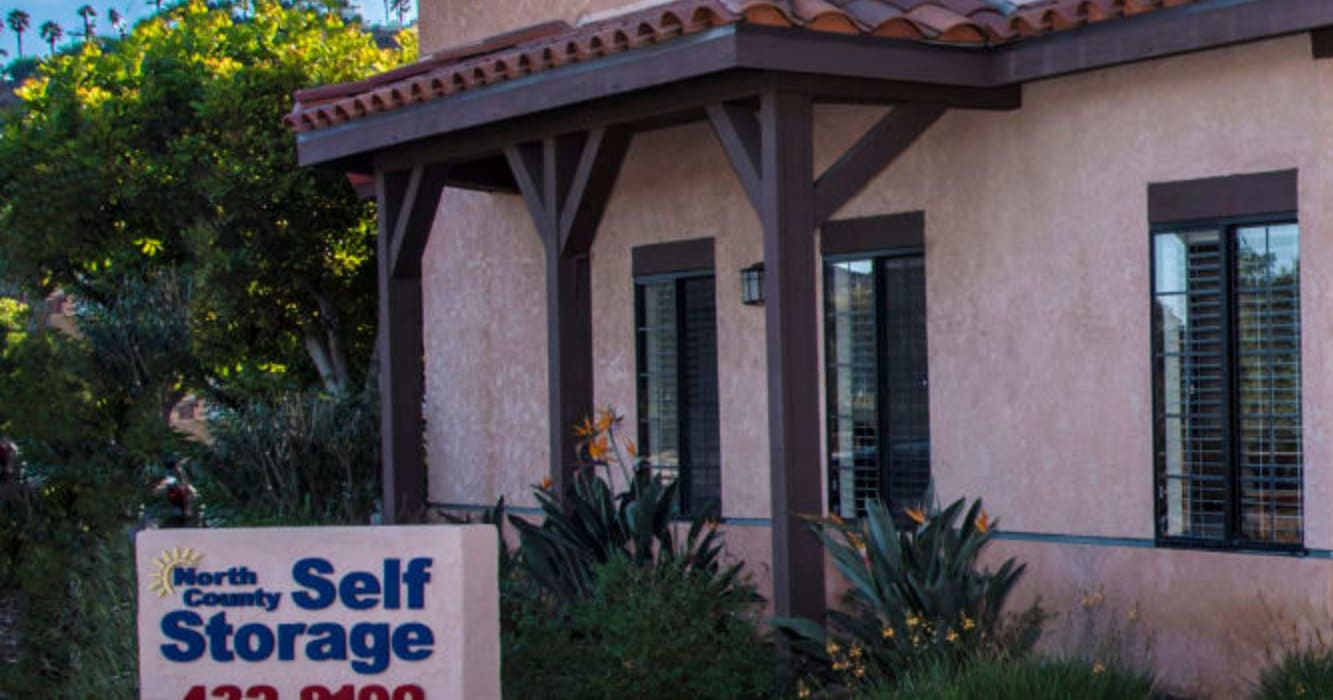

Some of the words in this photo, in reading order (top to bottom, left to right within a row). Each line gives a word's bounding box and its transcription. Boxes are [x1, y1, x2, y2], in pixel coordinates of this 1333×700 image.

[173, 566, 257, 587] North
[291, 557, 434, 611] Self
[183, 588, 282, 612] County
[159, 609, 435, 675] Storage
